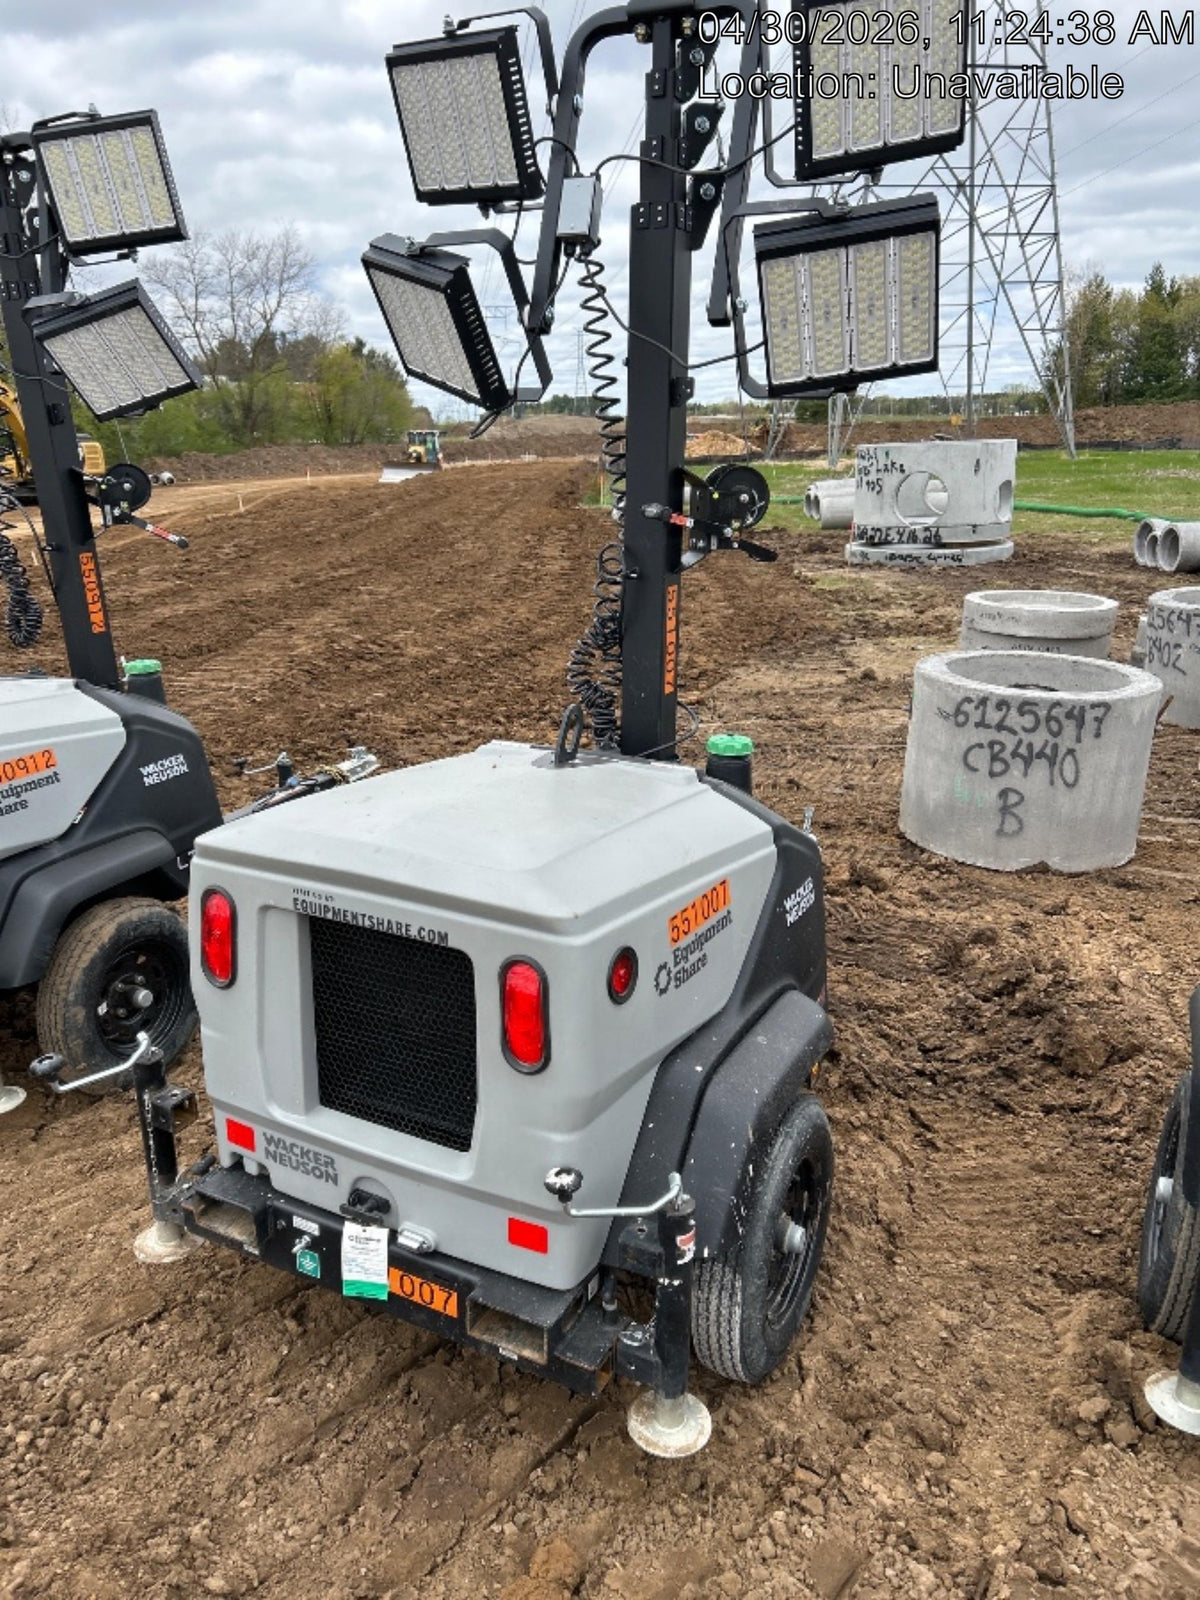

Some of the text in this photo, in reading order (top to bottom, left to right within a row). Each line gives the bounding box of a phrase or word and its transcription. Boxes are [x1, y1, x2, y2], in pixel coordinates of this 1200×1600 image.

[0, 749, 56, 783] 0912
[139, 753, 185, 775] WACKER
[143, 764, 189, 787] NEUSON
[0, 771, 60, 804] uipment
[292, 897, 449, 946] EQUIPMENTSHARE.COM
[671, 879, 728, 943] 551007
[672, 909, 733, 967] Equipment
[673, 952, 708, 989] Share
[263, 1131, 337, 1171] WACKER
[264, 1149, 339, 1186] NEUSON
